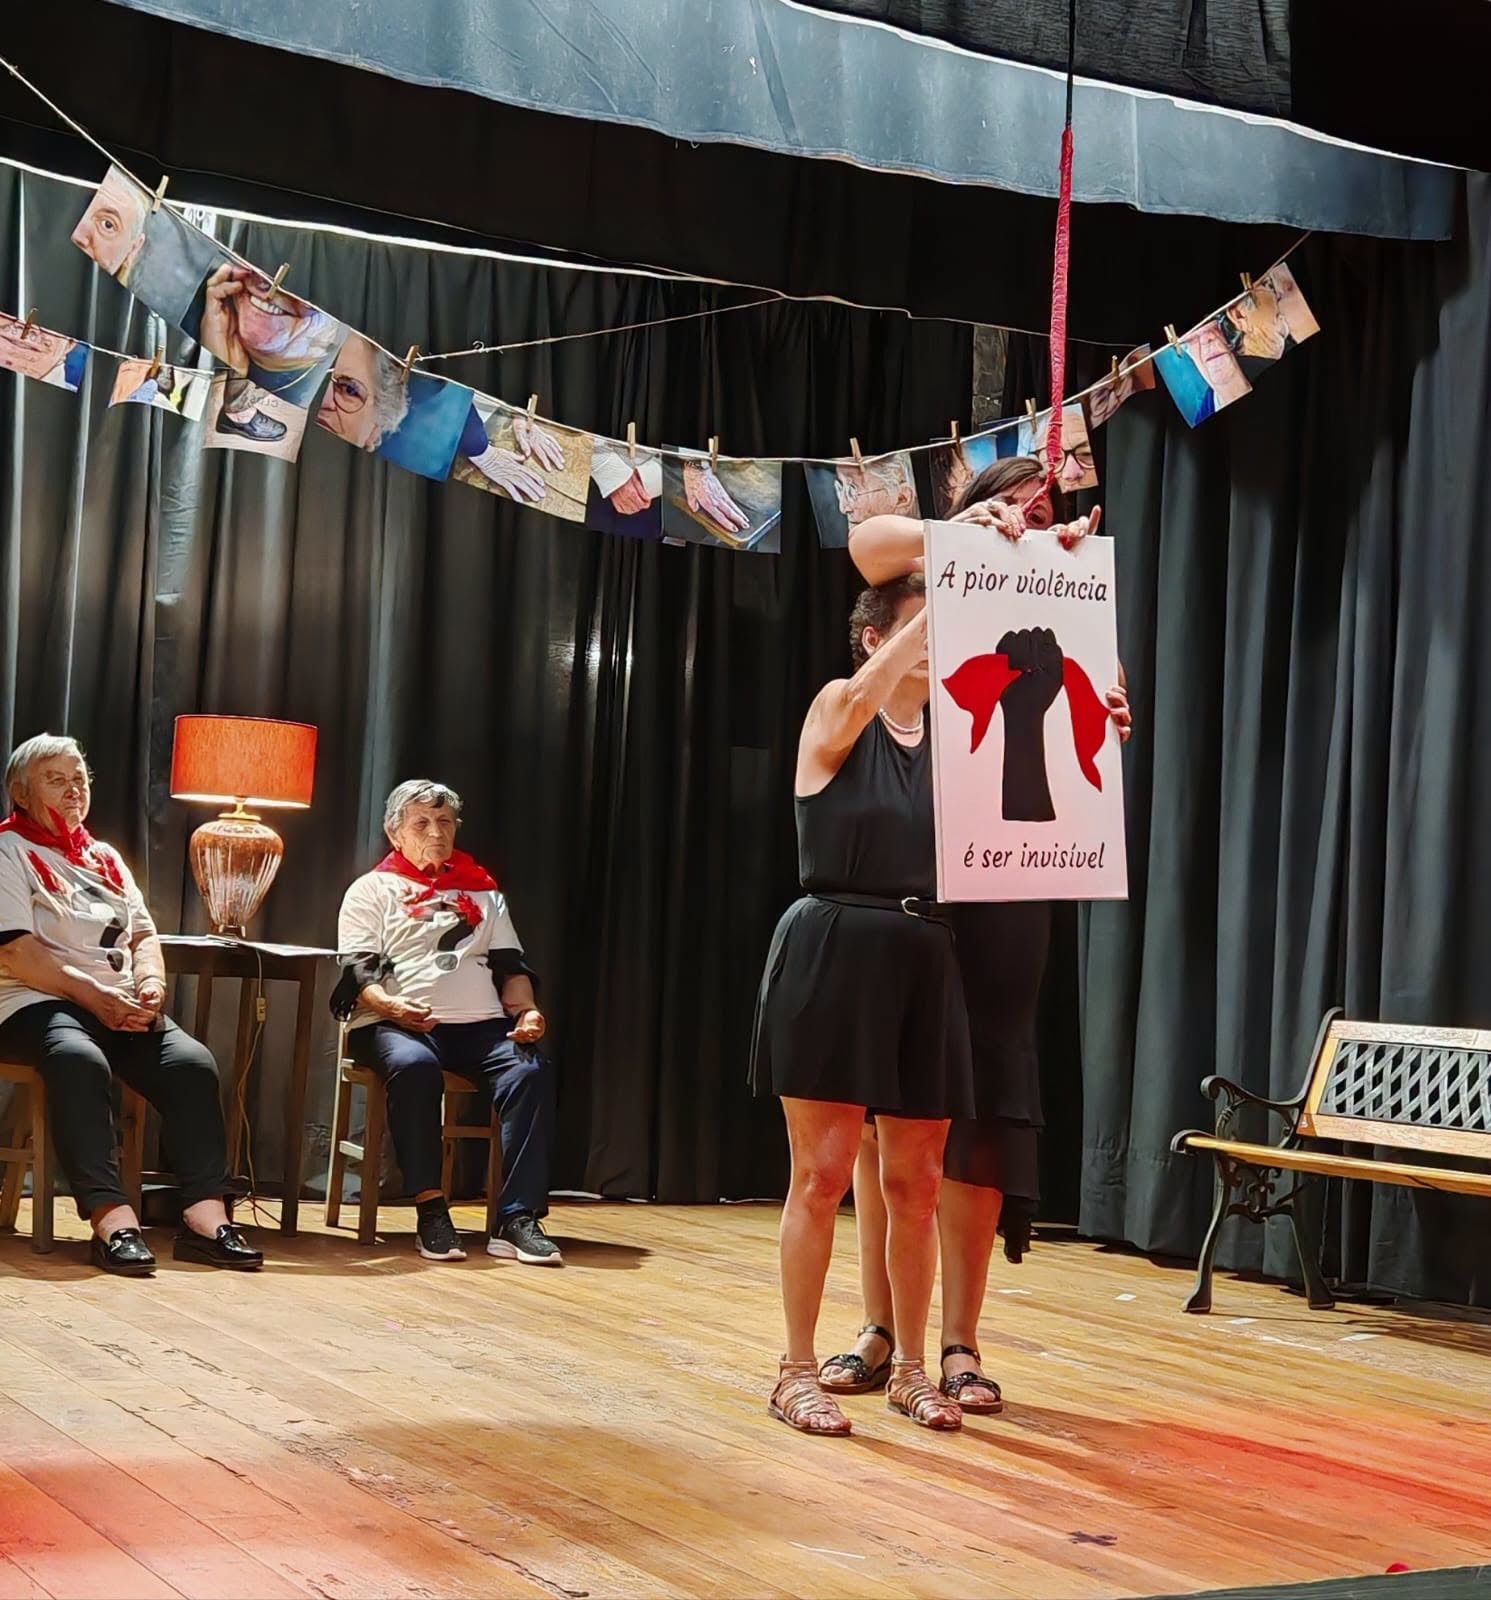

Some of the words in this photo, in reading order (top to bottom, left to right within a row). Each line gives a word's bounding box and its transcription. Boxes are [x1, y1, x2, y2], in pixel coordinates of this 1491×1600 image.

[937, 561, 956, 589] A
[963, 563, 1009, 598] pior
[1016, 568, 1107, 602] violência
[963, 841, 975, 868] é
[981, 849, 1013, 869] ser
[1020, 842, 1105, 869] invisível
